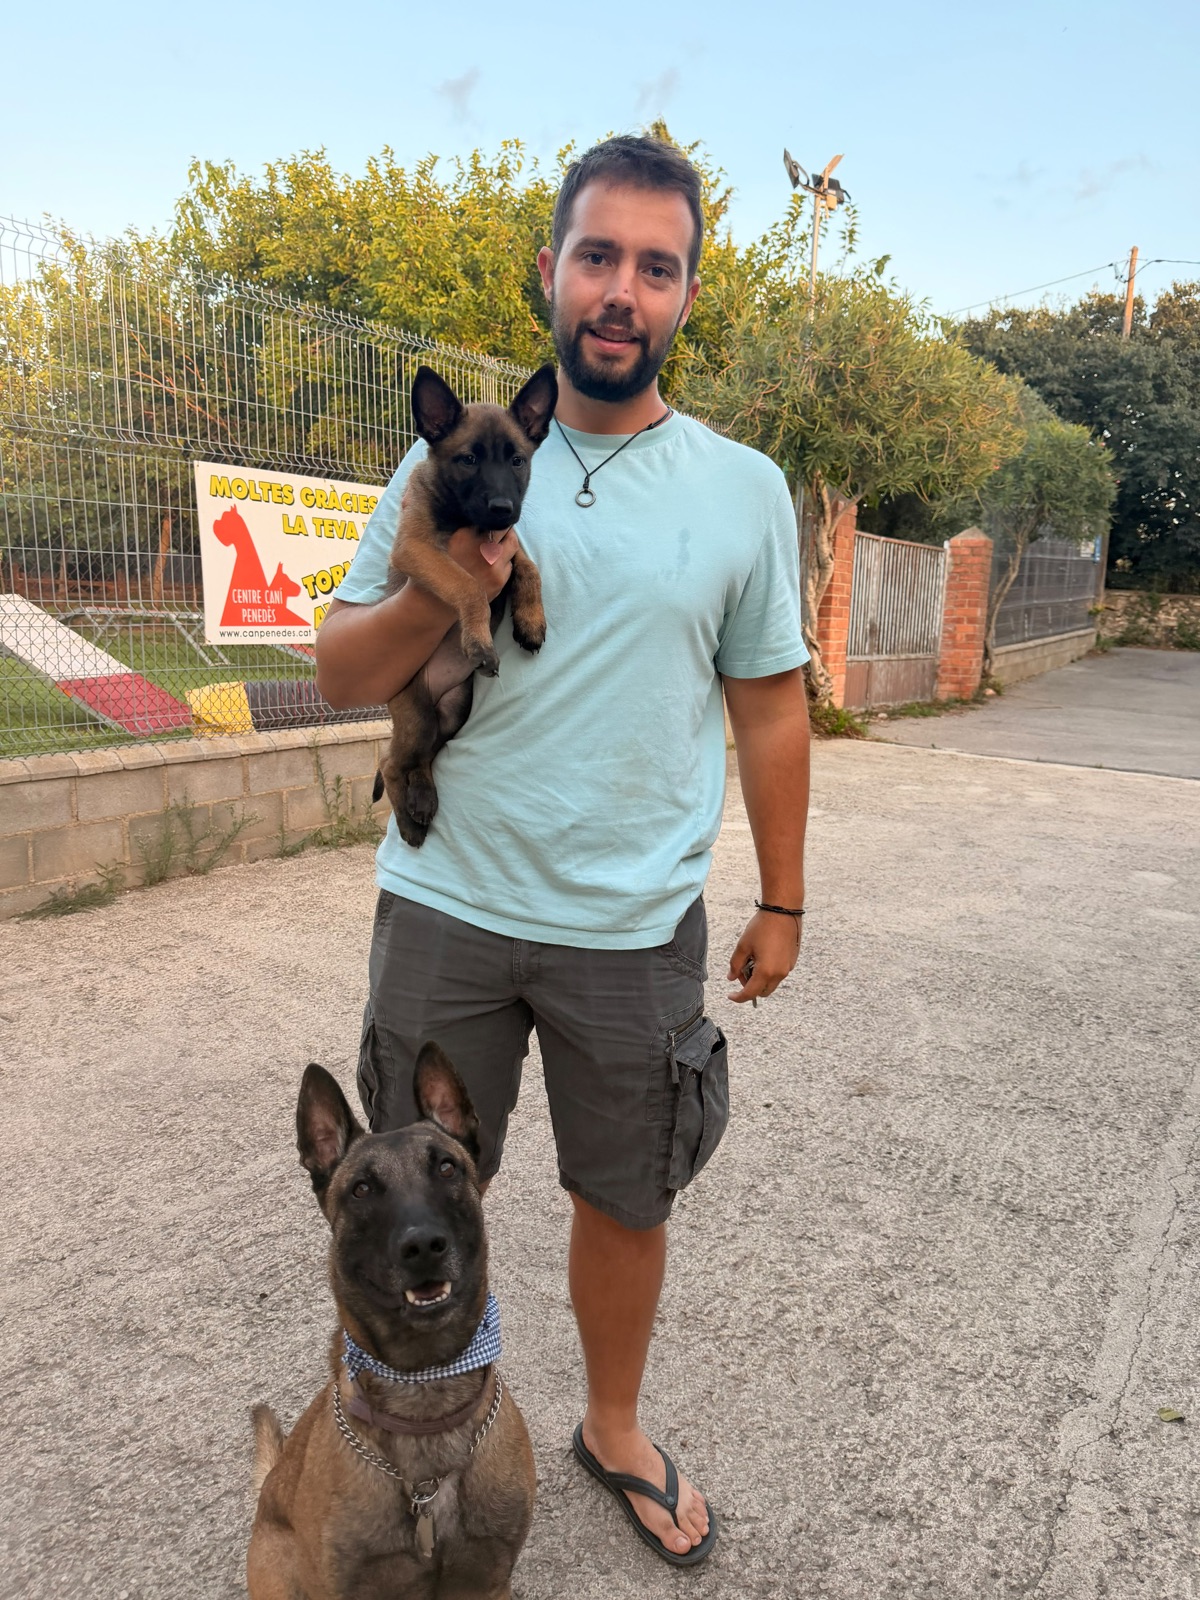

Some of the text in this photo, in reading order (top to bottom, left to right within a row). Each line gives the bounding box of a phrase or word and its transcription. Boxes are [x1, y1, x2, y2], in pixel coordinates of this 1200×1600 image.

[209, 475, 378, 514] MOLTES GRÀCIES
[282, 514, 360, 541] LA TEVA
[231, 587, 283, 605] CENTRE CANÍ
[241, 606, 277, 624] PENEDÈS
[219, 629, 312, 639] www.canpenedes.cat
